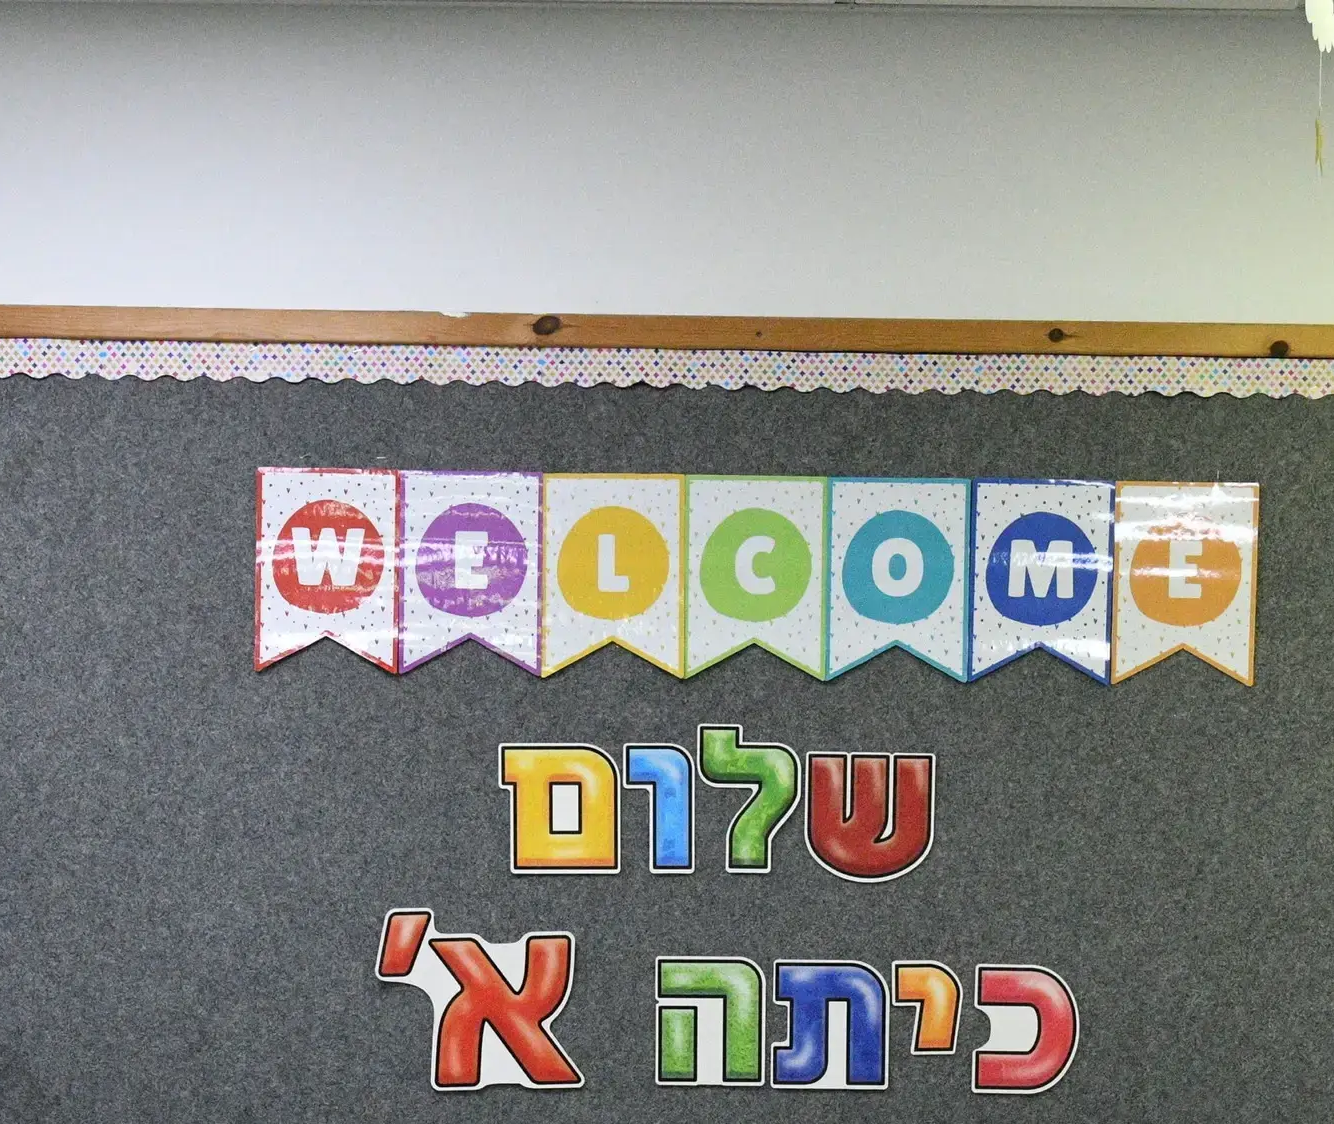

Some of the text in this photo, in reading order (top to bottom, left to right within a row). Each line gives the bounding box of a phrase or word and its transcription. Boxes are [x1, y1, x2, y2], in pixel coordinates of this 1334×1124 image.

[293, 526, 1203, 600] WELCOME
[501, 727, 933, 880] שלום
[656, 958, 1077, 1090] כיתה
